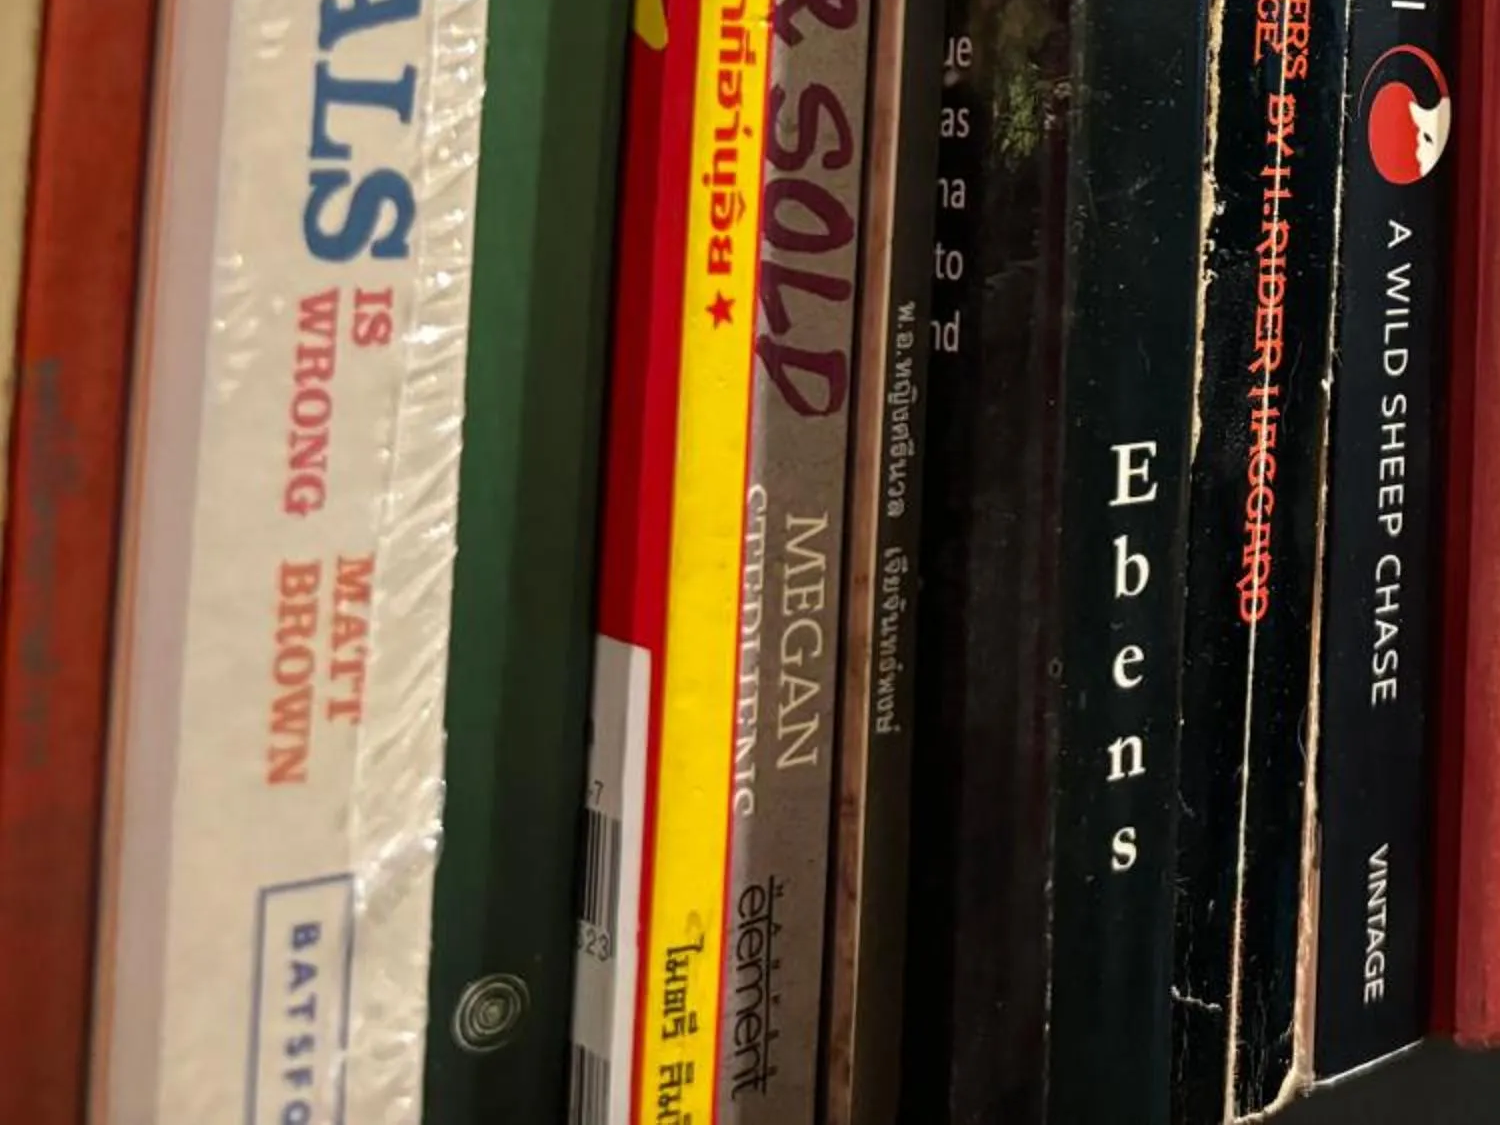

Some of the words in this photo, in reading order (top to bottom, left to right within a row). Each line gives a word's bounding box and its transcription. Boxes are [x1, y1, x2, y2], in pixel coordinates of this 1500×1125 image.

[1266, 93, 1296, 157] BY
[757, 83, 855, 417] SOLD
[1250, 222, 1287, 373] RIDER
[1387, 219, 1411, 248] A
[283, 288, 339, 515] WRONG
[351, 289, 395, 347] IS
[1382, 263, 1410, 375] WILD
[1236, 385, 1281, 622] HAGGARD
[1377, 394, 1406, 536] SHEEP
[266, 559, 319, 786] BROWN
[326, 555, 374, 727] MATT
[776, 512, 829, 772] MEGAN
[1107, 442, 1158, 872] Ebens
[1370, 554, 1402, 708] CHASE
[731, 884, 769, 1101] element
[1363, 842, 1389, 1005] VINTAGE
